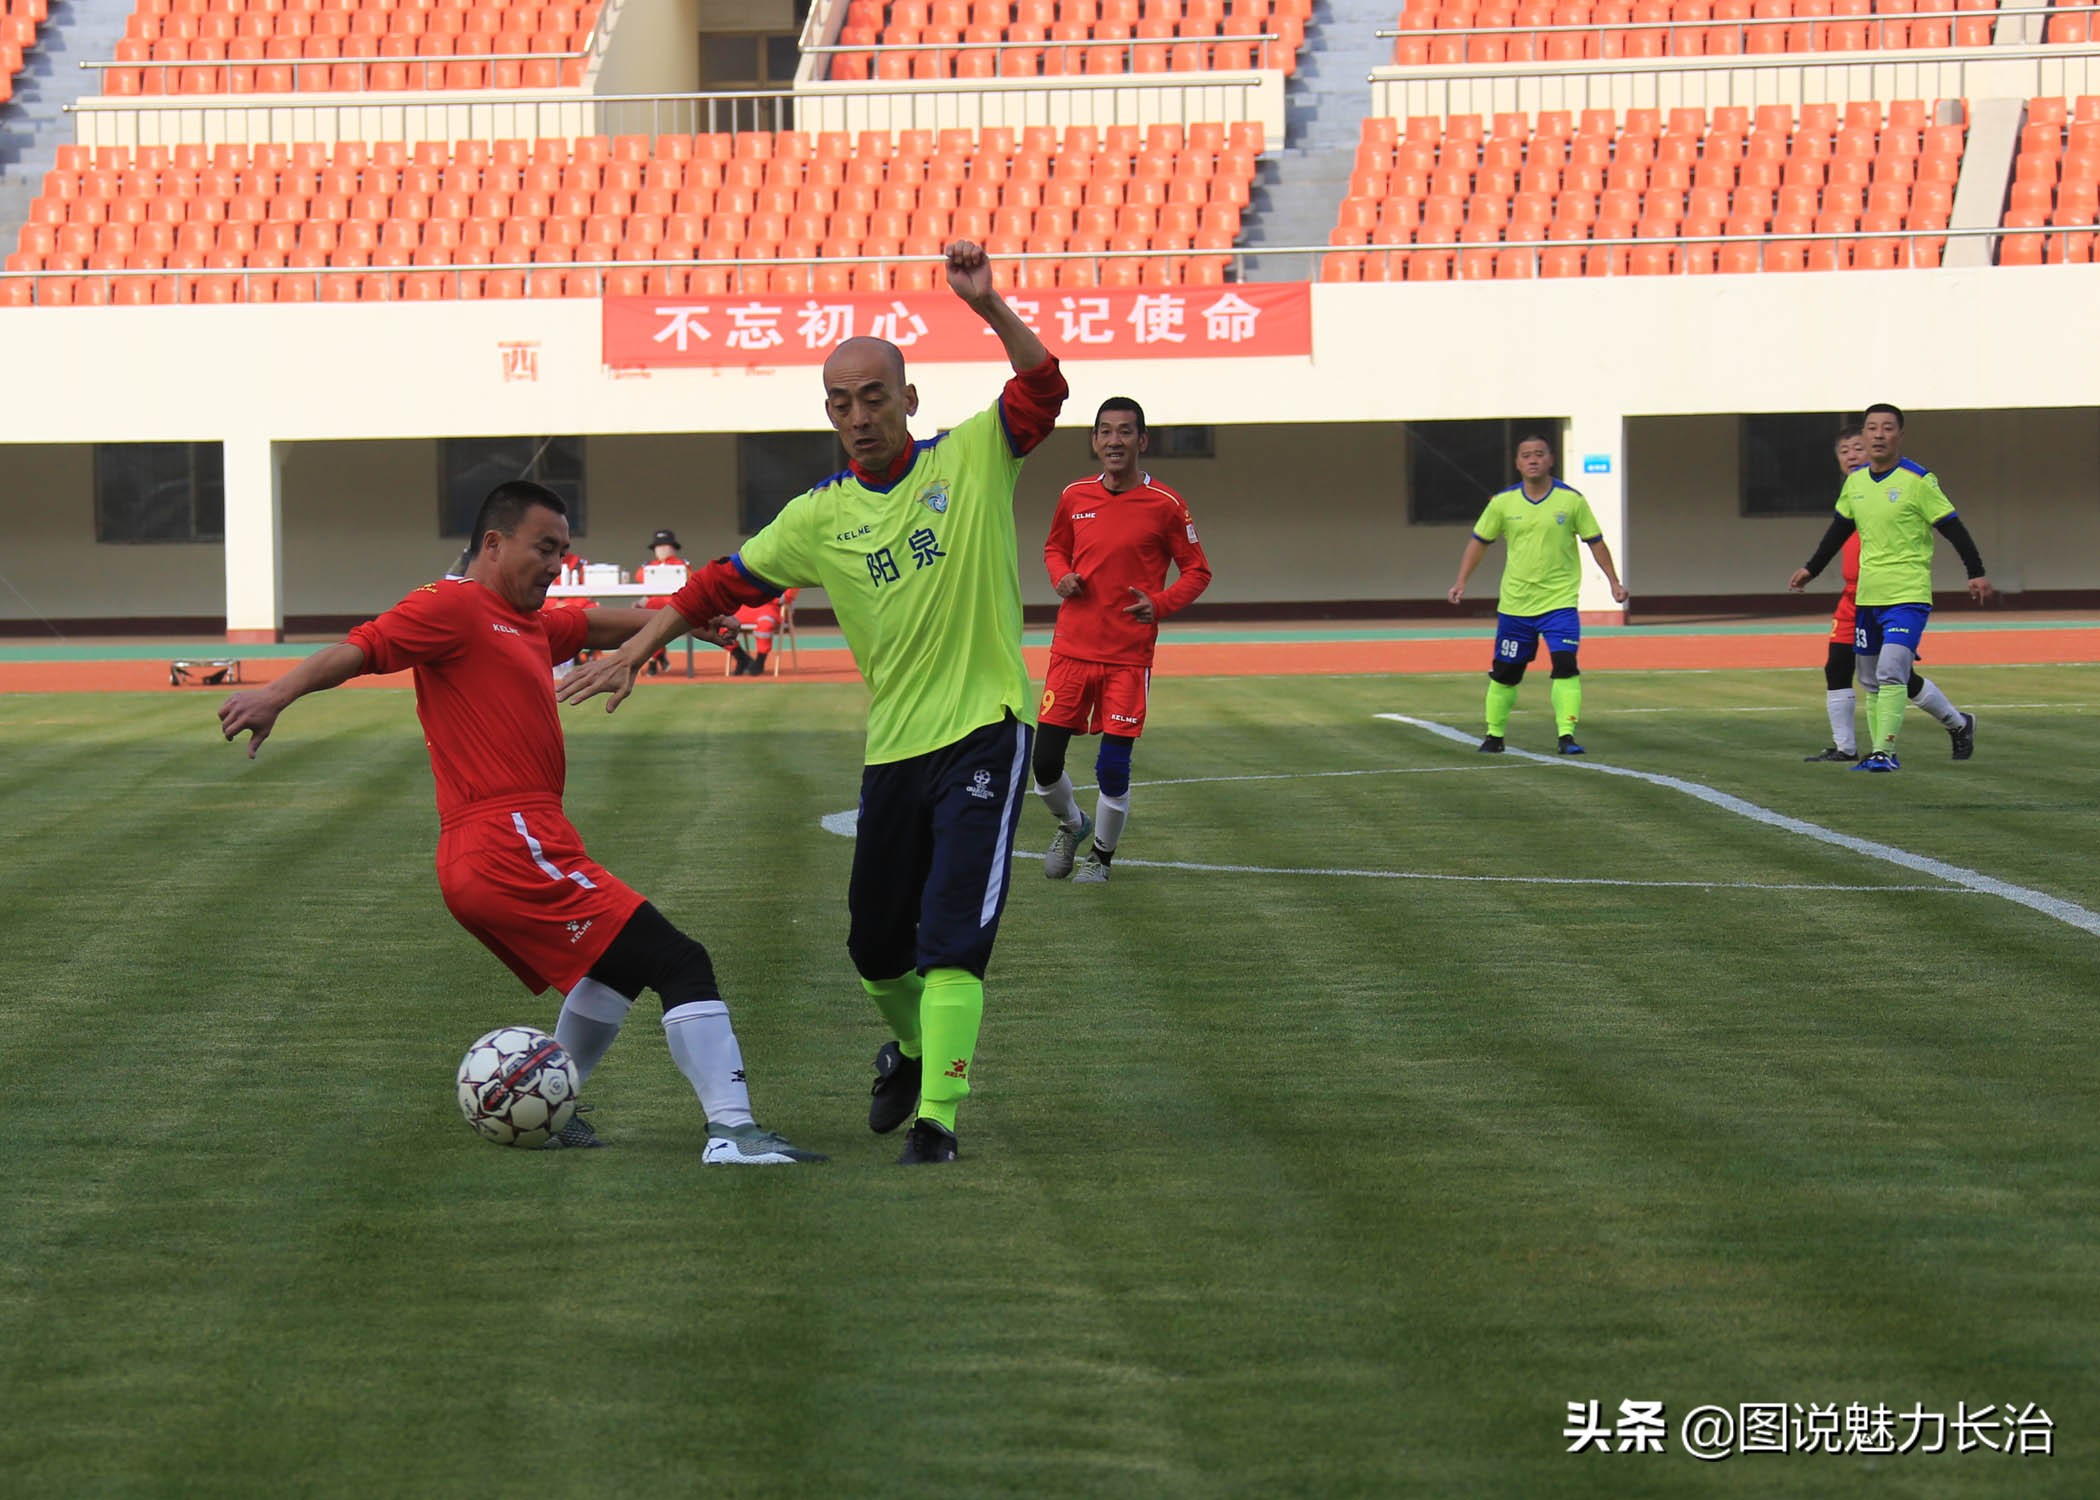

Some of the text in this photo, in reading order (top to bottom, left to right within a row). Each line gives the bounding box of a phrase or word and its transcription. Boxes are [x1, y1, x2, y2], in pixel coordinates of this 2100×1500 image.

[652, 300, 930, 351] 不忘初心
[1071, 512, 1097, 520] KELME
[836, 525, 871, 542] KELME
[865, 527, 947, 588] 阳泉
[1500, 639, 1518, 658] 99
[1041, 689, 1055, 716] 9
[1111, 713, 1138, 724] KELME
